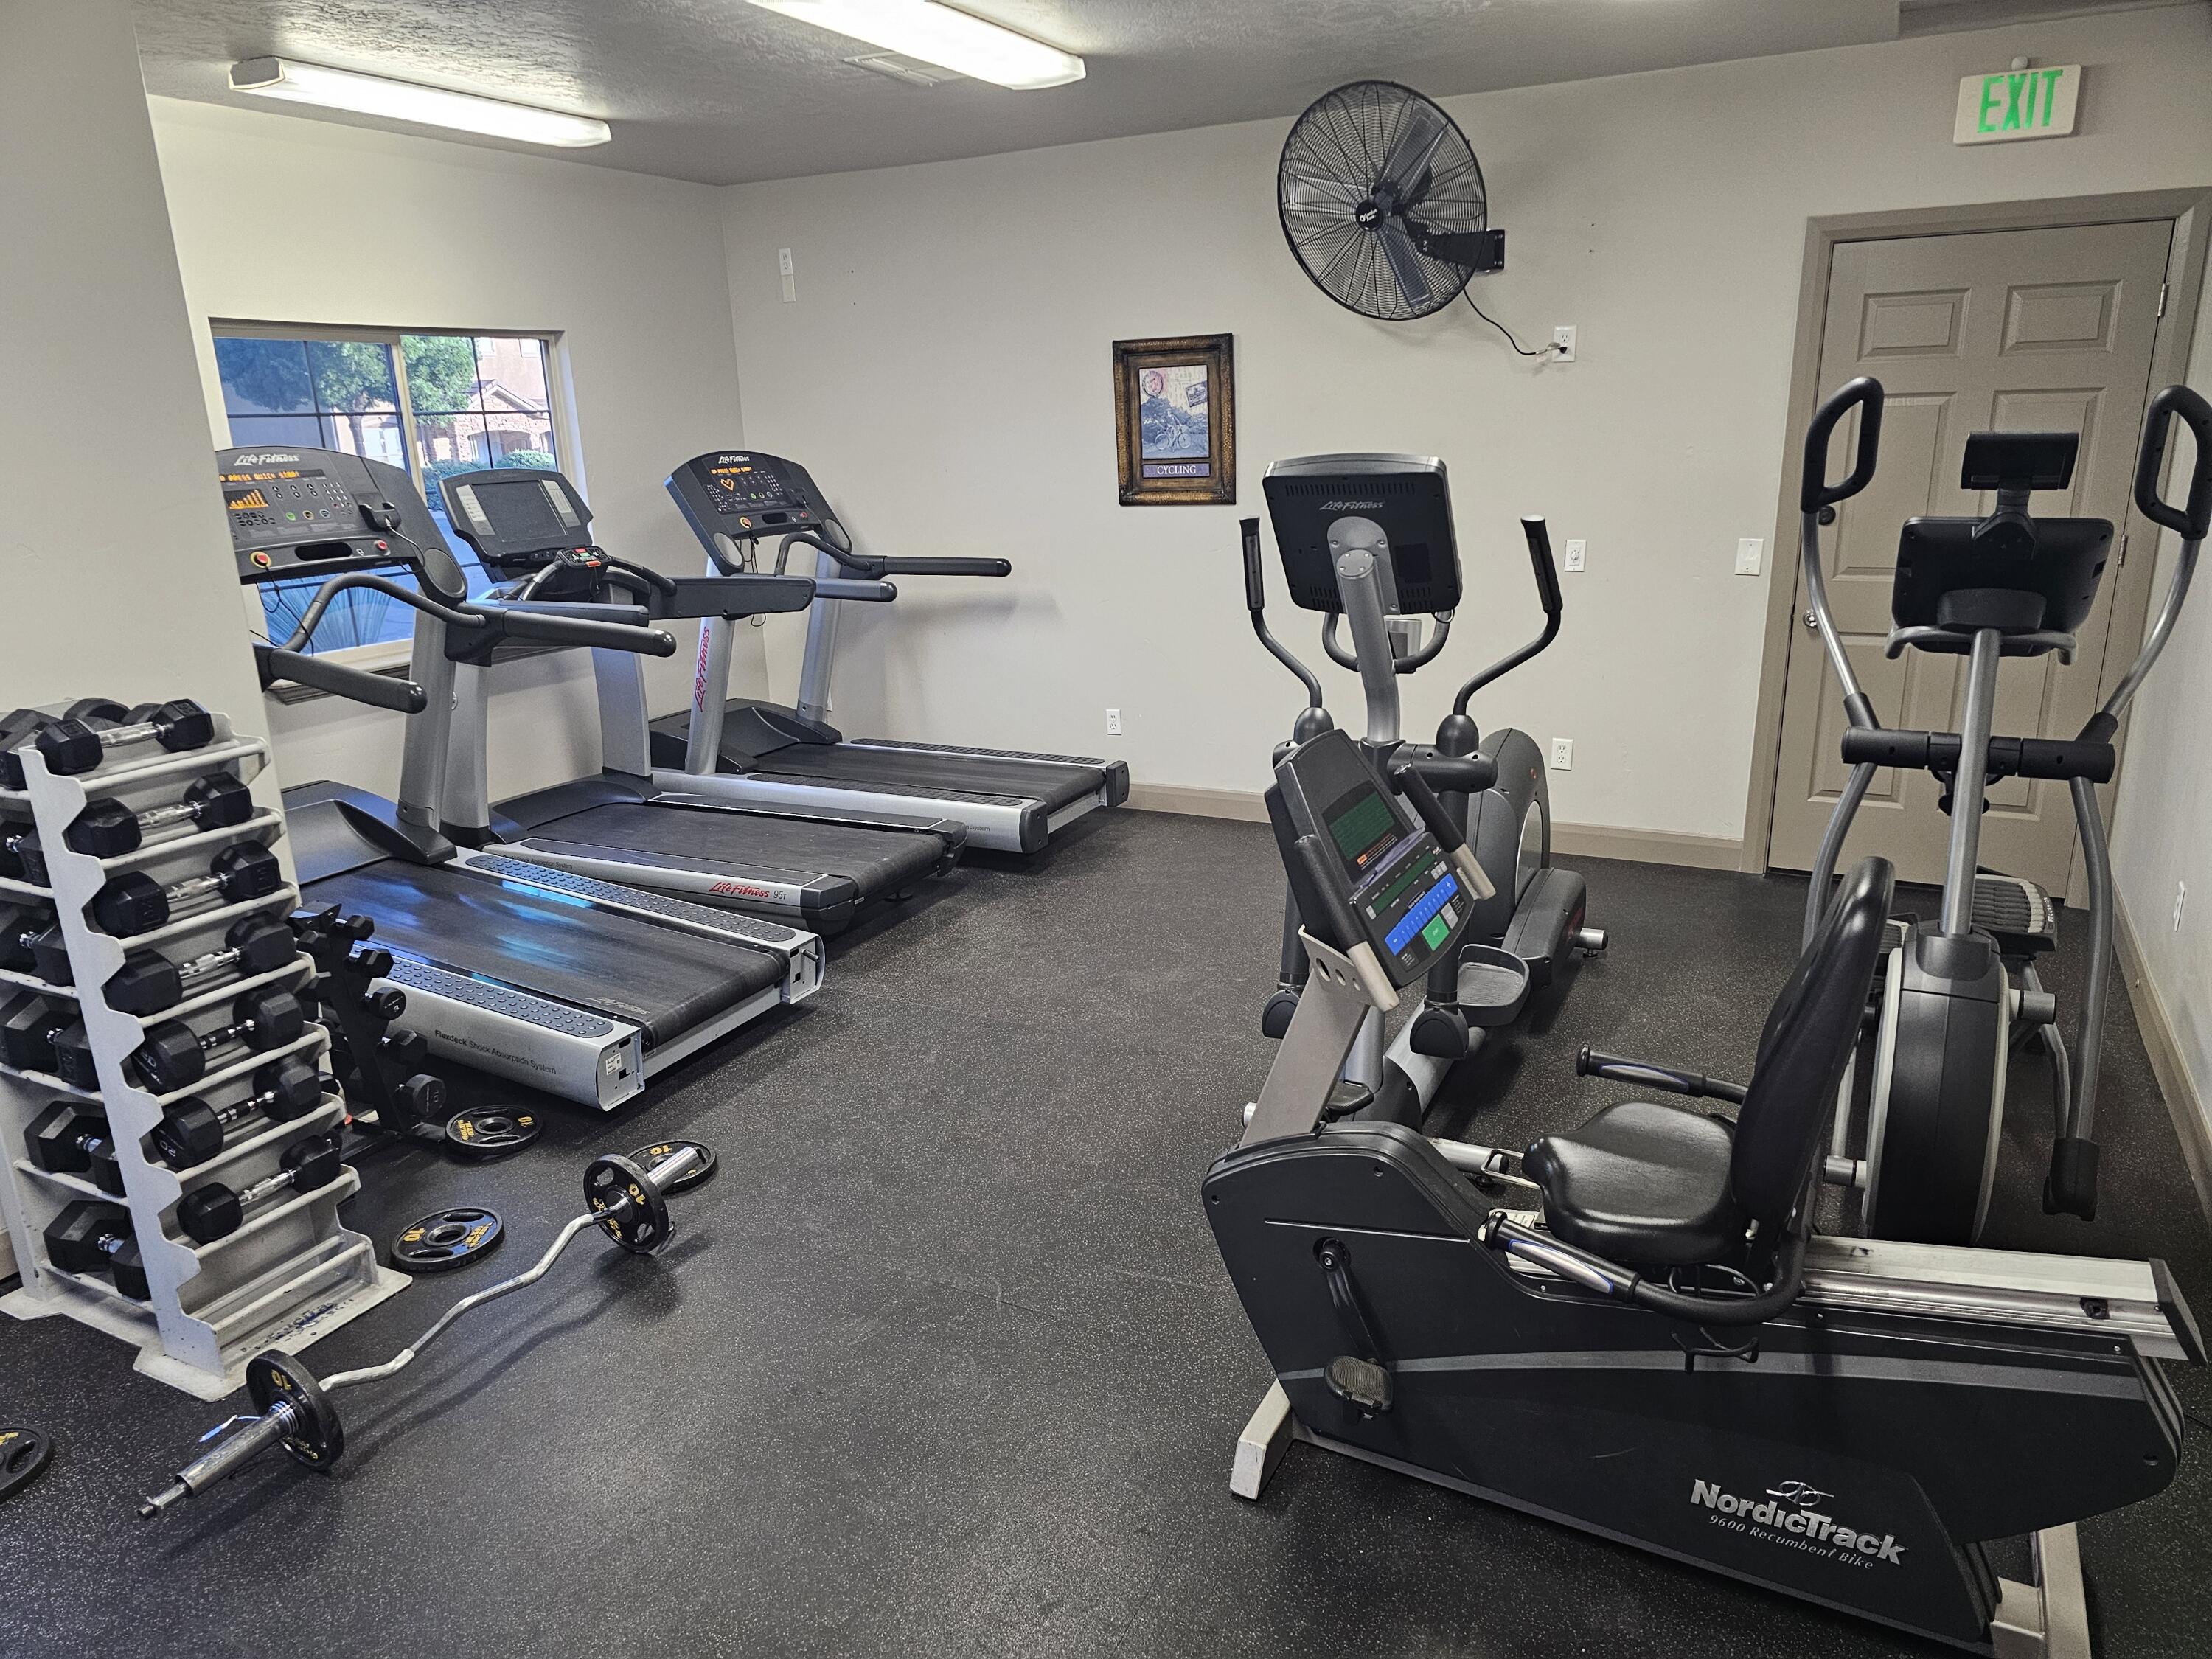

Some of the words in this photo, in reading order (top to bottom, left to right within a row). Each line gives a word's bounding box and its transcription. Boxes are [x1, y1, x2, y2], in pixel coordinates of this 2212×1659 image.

[1977, 69, 2064, 133] EXIT
[1156, 465, 1197, 475] CYCLING
[434, 1029, 467, 1046] Flexdeck
[469, 1040, 491, 1054] Shock
[491, 1048, 529, 1066] Absorption
[530, 1060, 557, 1074] System
[629, 1183, 646, 1206] 10
[403, 1228, 426, 1242] 10
[271, 1369, 292, 1391] 10
[1690, 1478, 1909, 1565] NordicTrack
[1708, 1514, 1746, 1533] 9600
[1748, 1526, 1837, 1559] Recumbent
[1837, 1551, 1874, 1570] Bike
